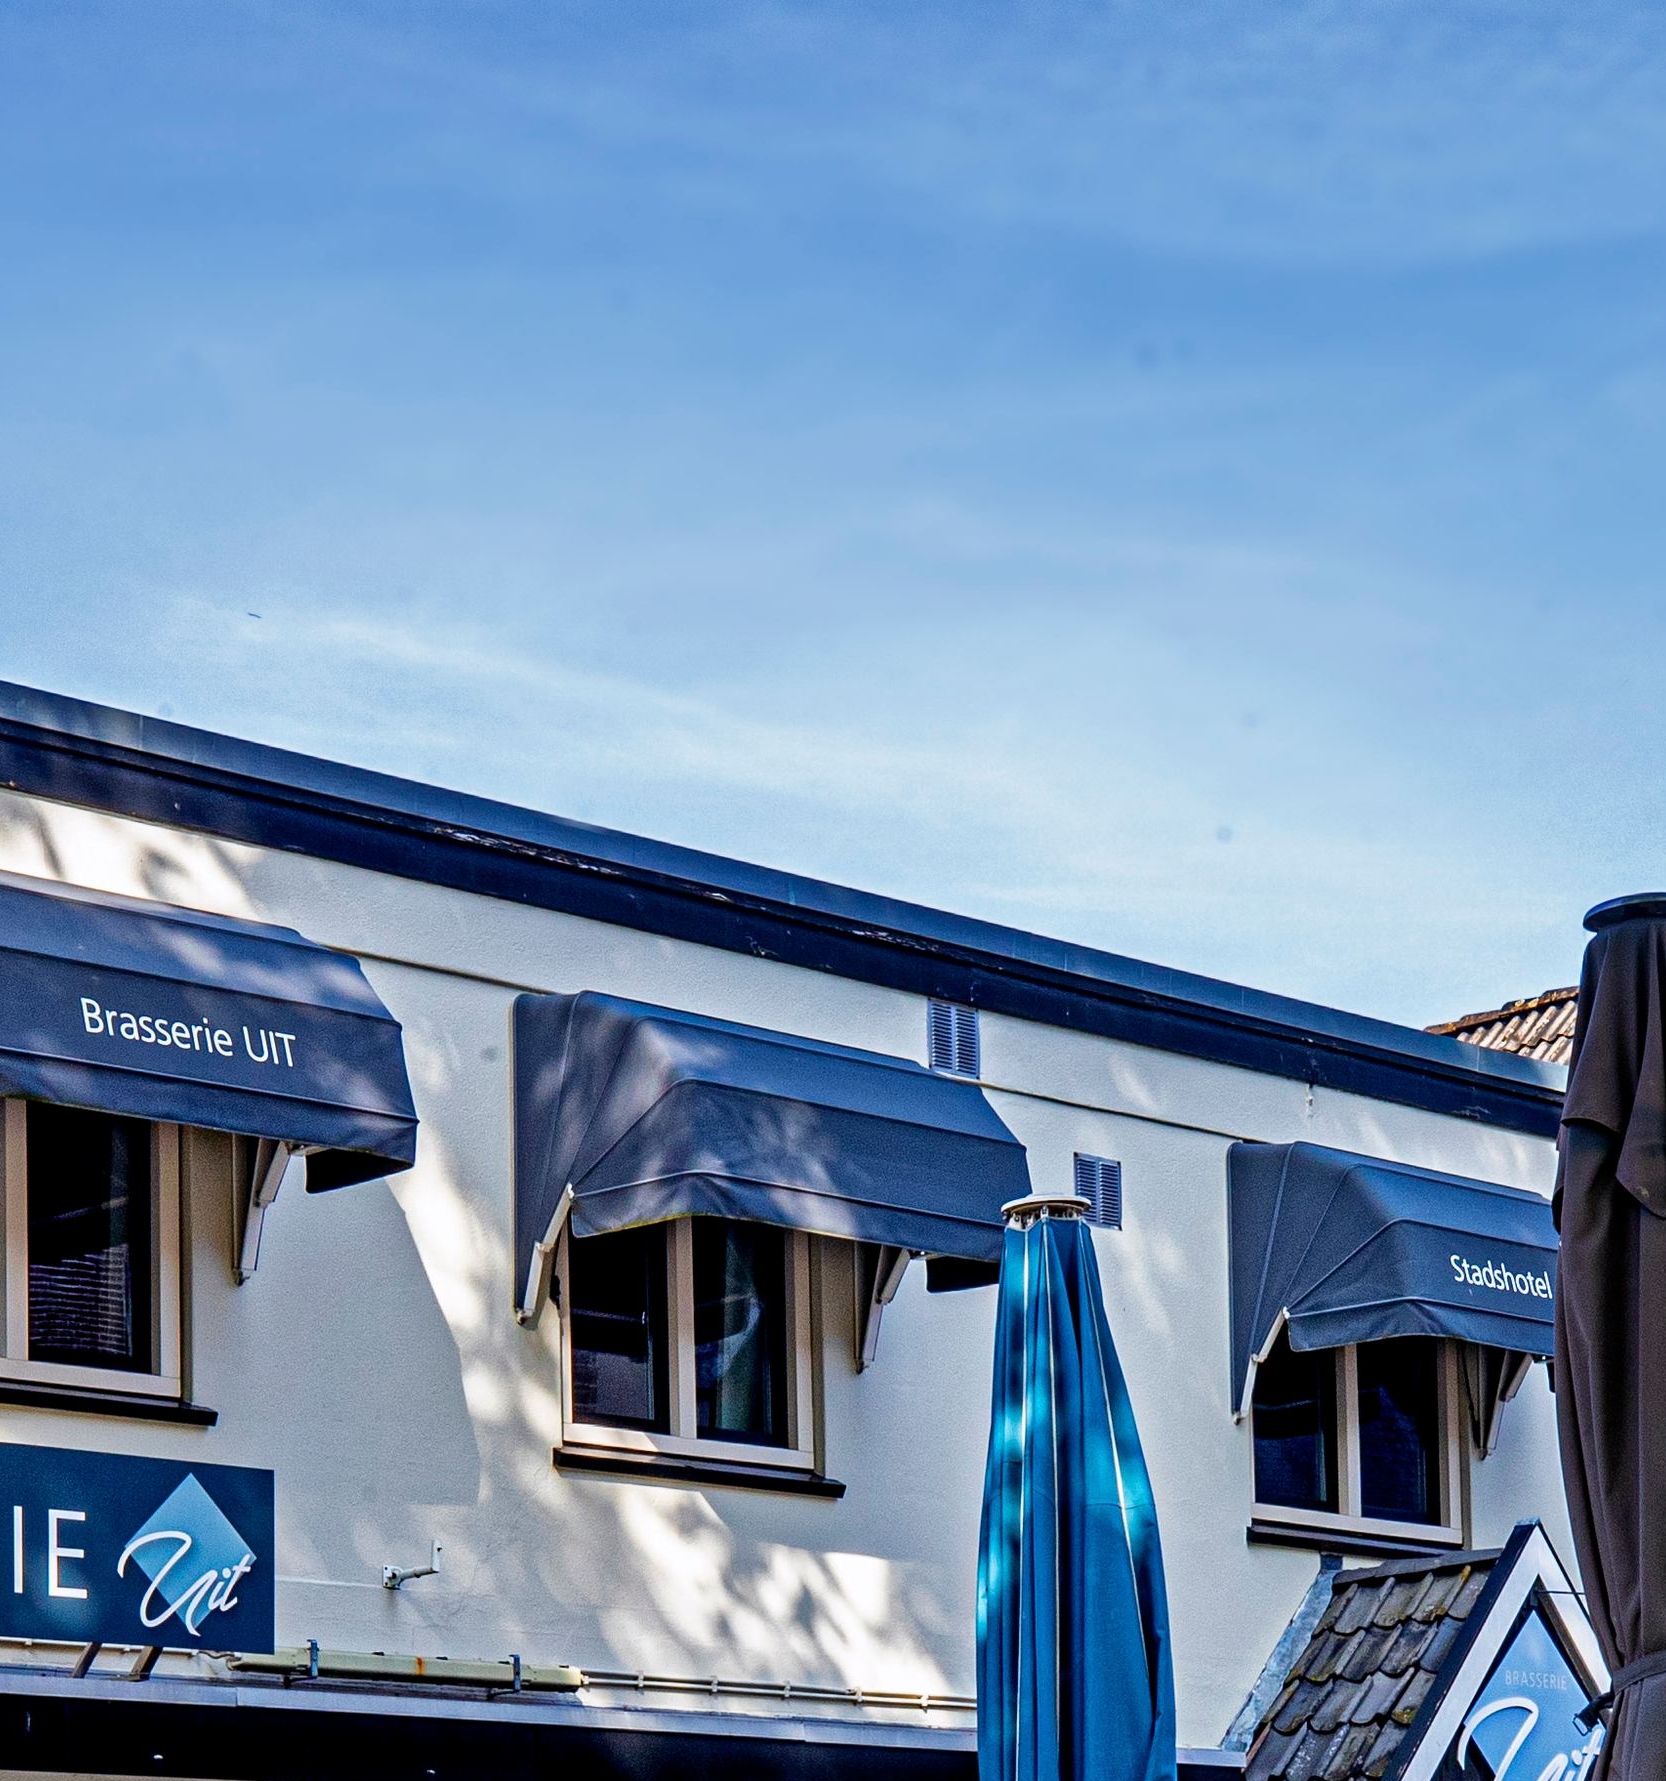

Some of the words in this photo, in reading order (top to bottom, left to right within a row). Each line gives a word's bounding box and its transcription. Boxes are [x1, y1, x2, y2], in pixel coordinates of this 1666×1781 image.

[80, 997, 234, 1057] Brasserie
[242, 1025, 296, 1068] UIT
[1449, 1254, 1554, 1299] Stadshotel
[116, 1530, 254, 1638] Uit
[1504, 1669, 1568, 1692] BRASSERIE
